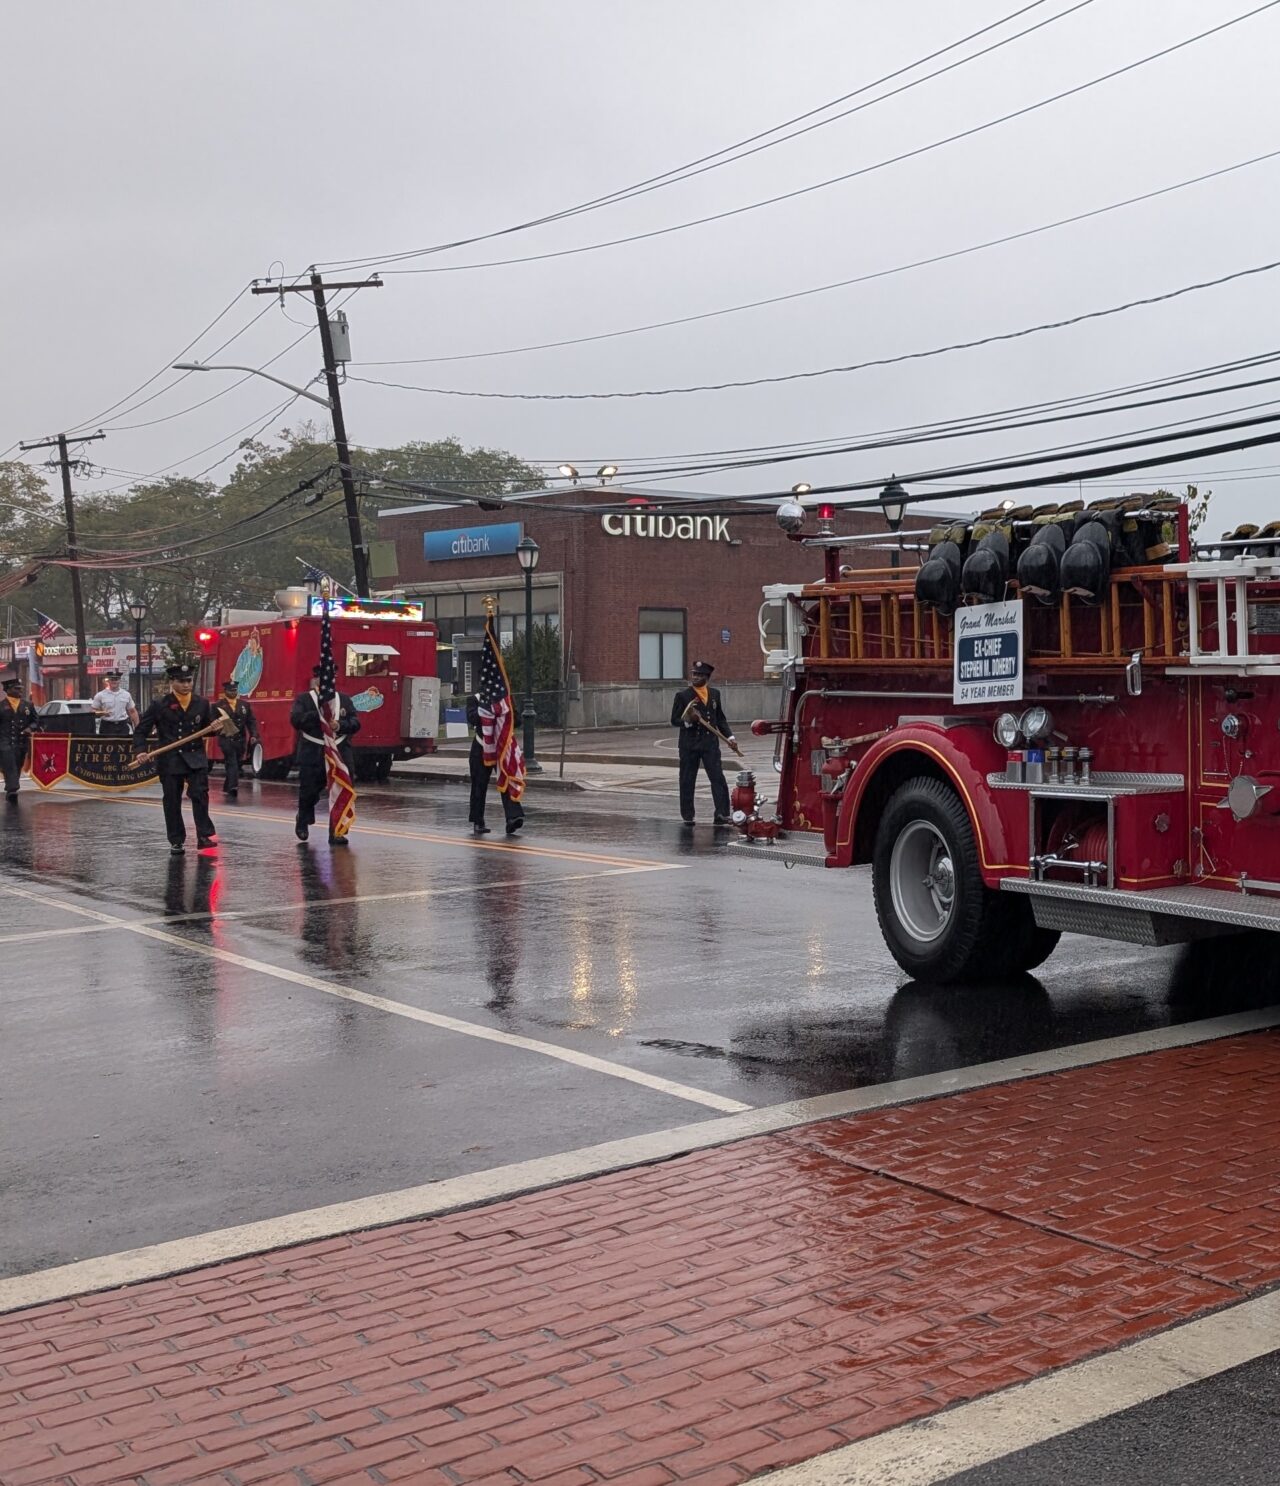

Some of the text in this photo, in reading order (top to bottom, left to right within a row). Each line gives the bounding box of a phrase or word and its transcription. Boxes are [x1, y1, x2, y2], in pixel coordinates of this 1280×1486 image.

[601, 505, 731, 541] citibank
[452, 533, 490, 554] citibank
[960, 610, 1017, 634] Grand Marshal
[974, 638, 1003, 658] EX-CHIEF
[960, 657, 1016, 679] STEPHEN M. DOHERTY
[961, 684, 1015, 699] 54 YEAR MEMBER
[75, 753, 111, 762] FIRE
